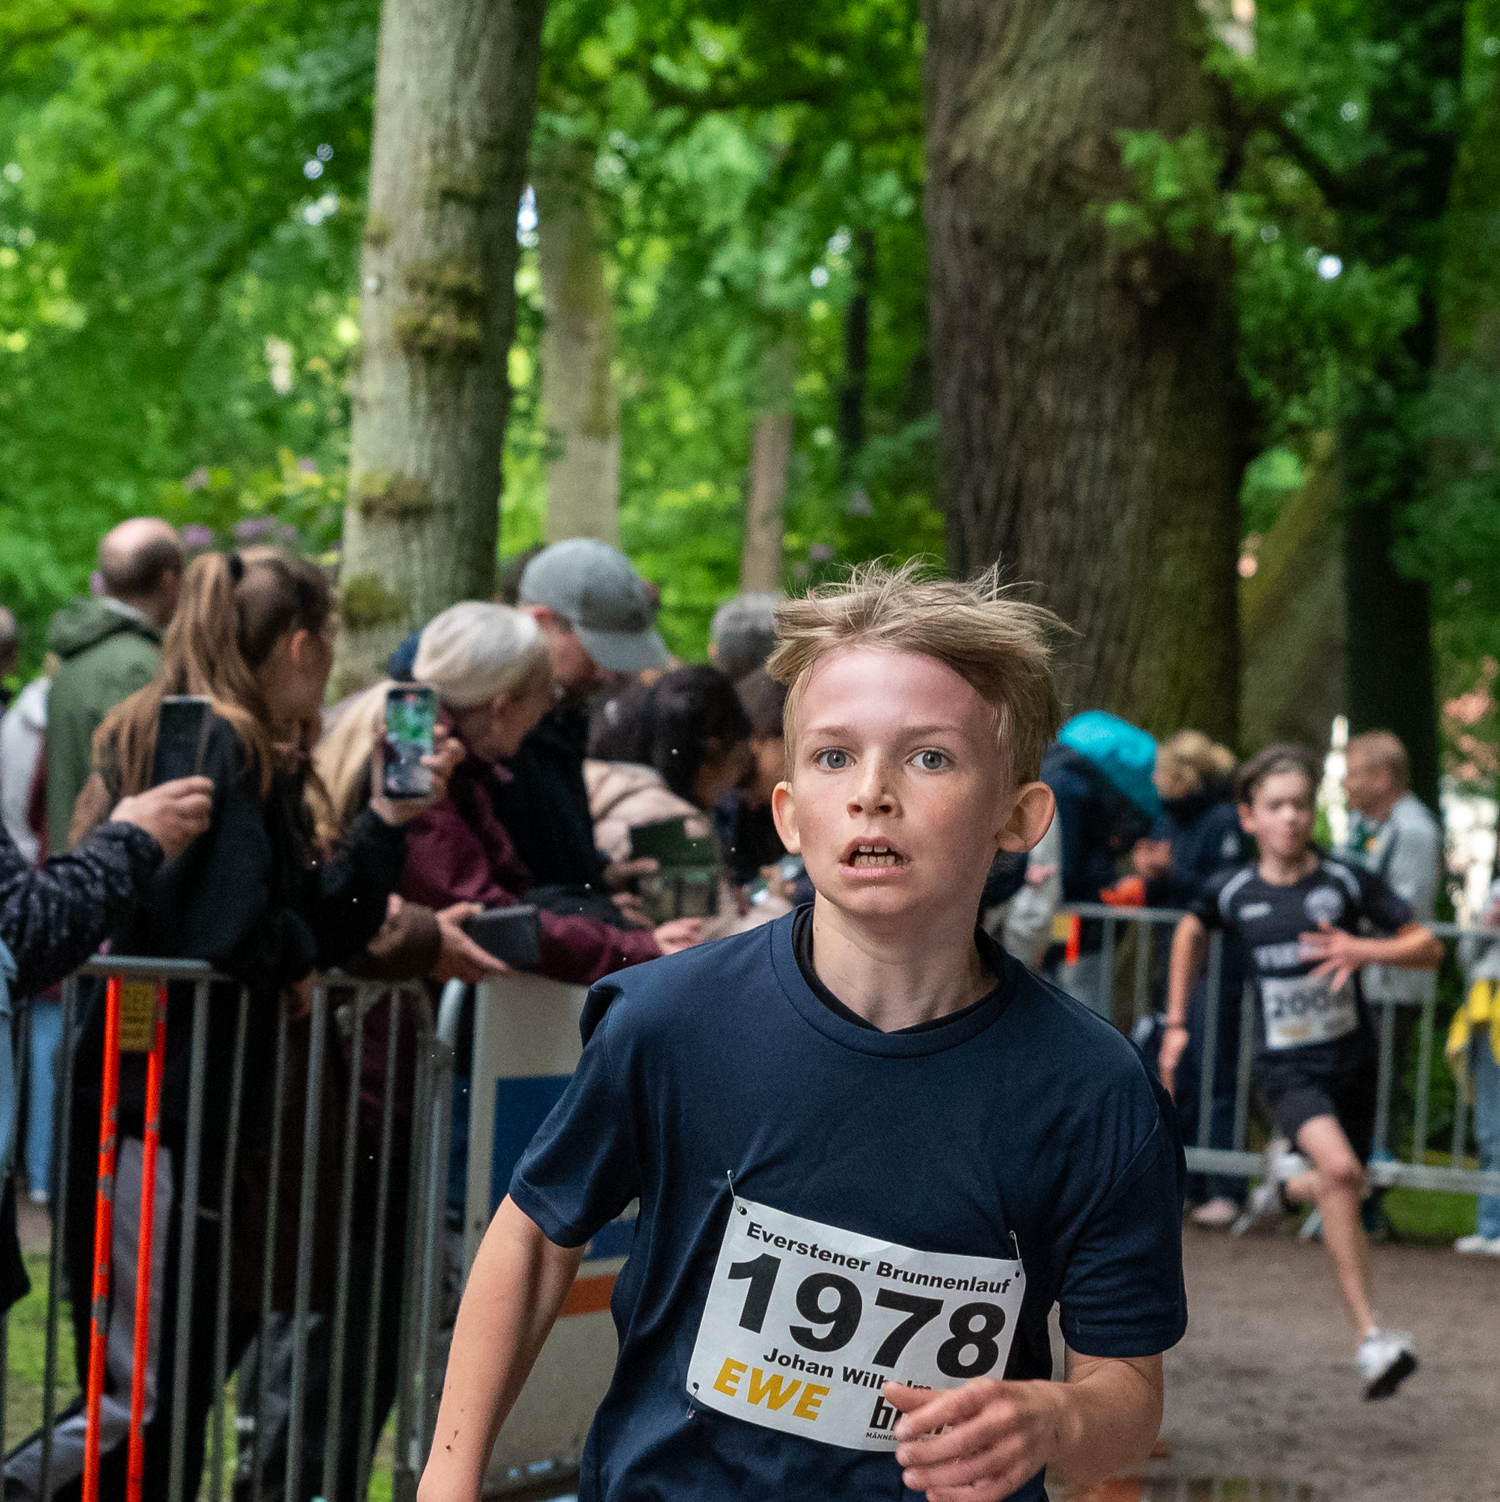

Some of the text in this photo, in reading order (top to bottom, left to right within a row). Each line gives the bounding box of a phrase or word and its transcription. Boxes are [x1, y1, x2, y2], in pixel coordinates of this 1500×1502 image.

[746, 1221, 1011, 1294] Everstener Brunnenlauf
[727, 1252, 1006, 1379] 1978
[713, 1357, 831, 1421] EWE
[763, 1347, 834, 1378] Johan
